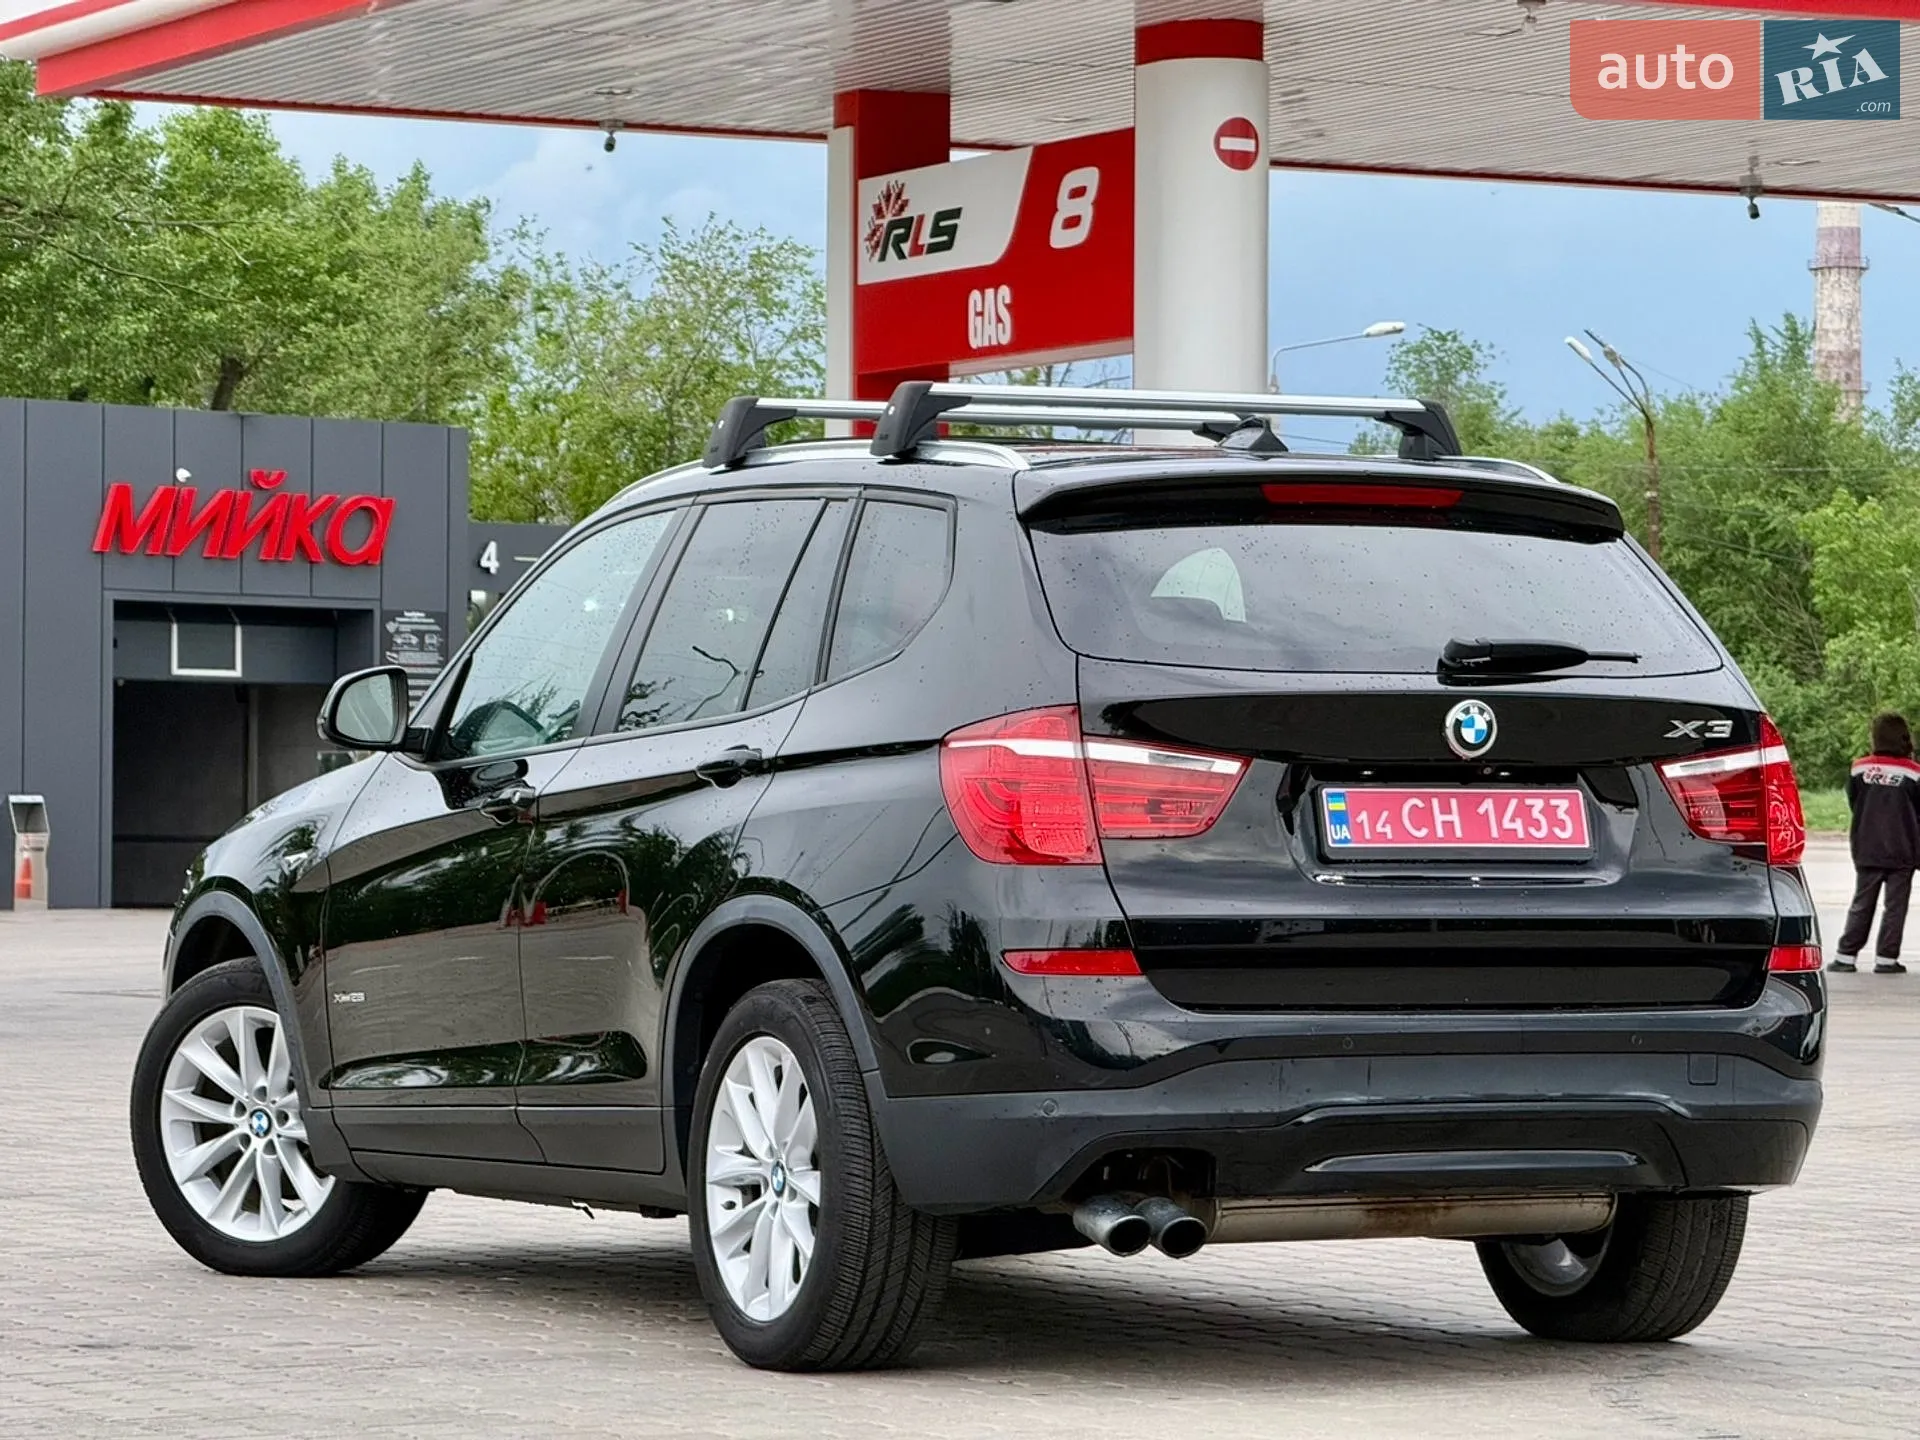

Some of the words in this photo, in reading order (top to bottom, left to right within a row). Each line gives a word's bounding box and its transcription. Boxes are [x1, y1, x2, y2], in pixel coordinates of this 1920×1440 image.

[1049, 166, 1100, 249] 8
[878, 206, 963, 263] RLS
[967, 284, 1014, 350] GAS
[479, 540, 500, 575] 4
[1663, 719, 1734, 739] X3
[1870, 773, 1903, 786] RLS
[1331, 823, 1351, 841] UA
[1355, 810, 1393, 840] 14
[1401, 797, 1463, 839] CH
[1476, 797, 1574, 839] 1433
